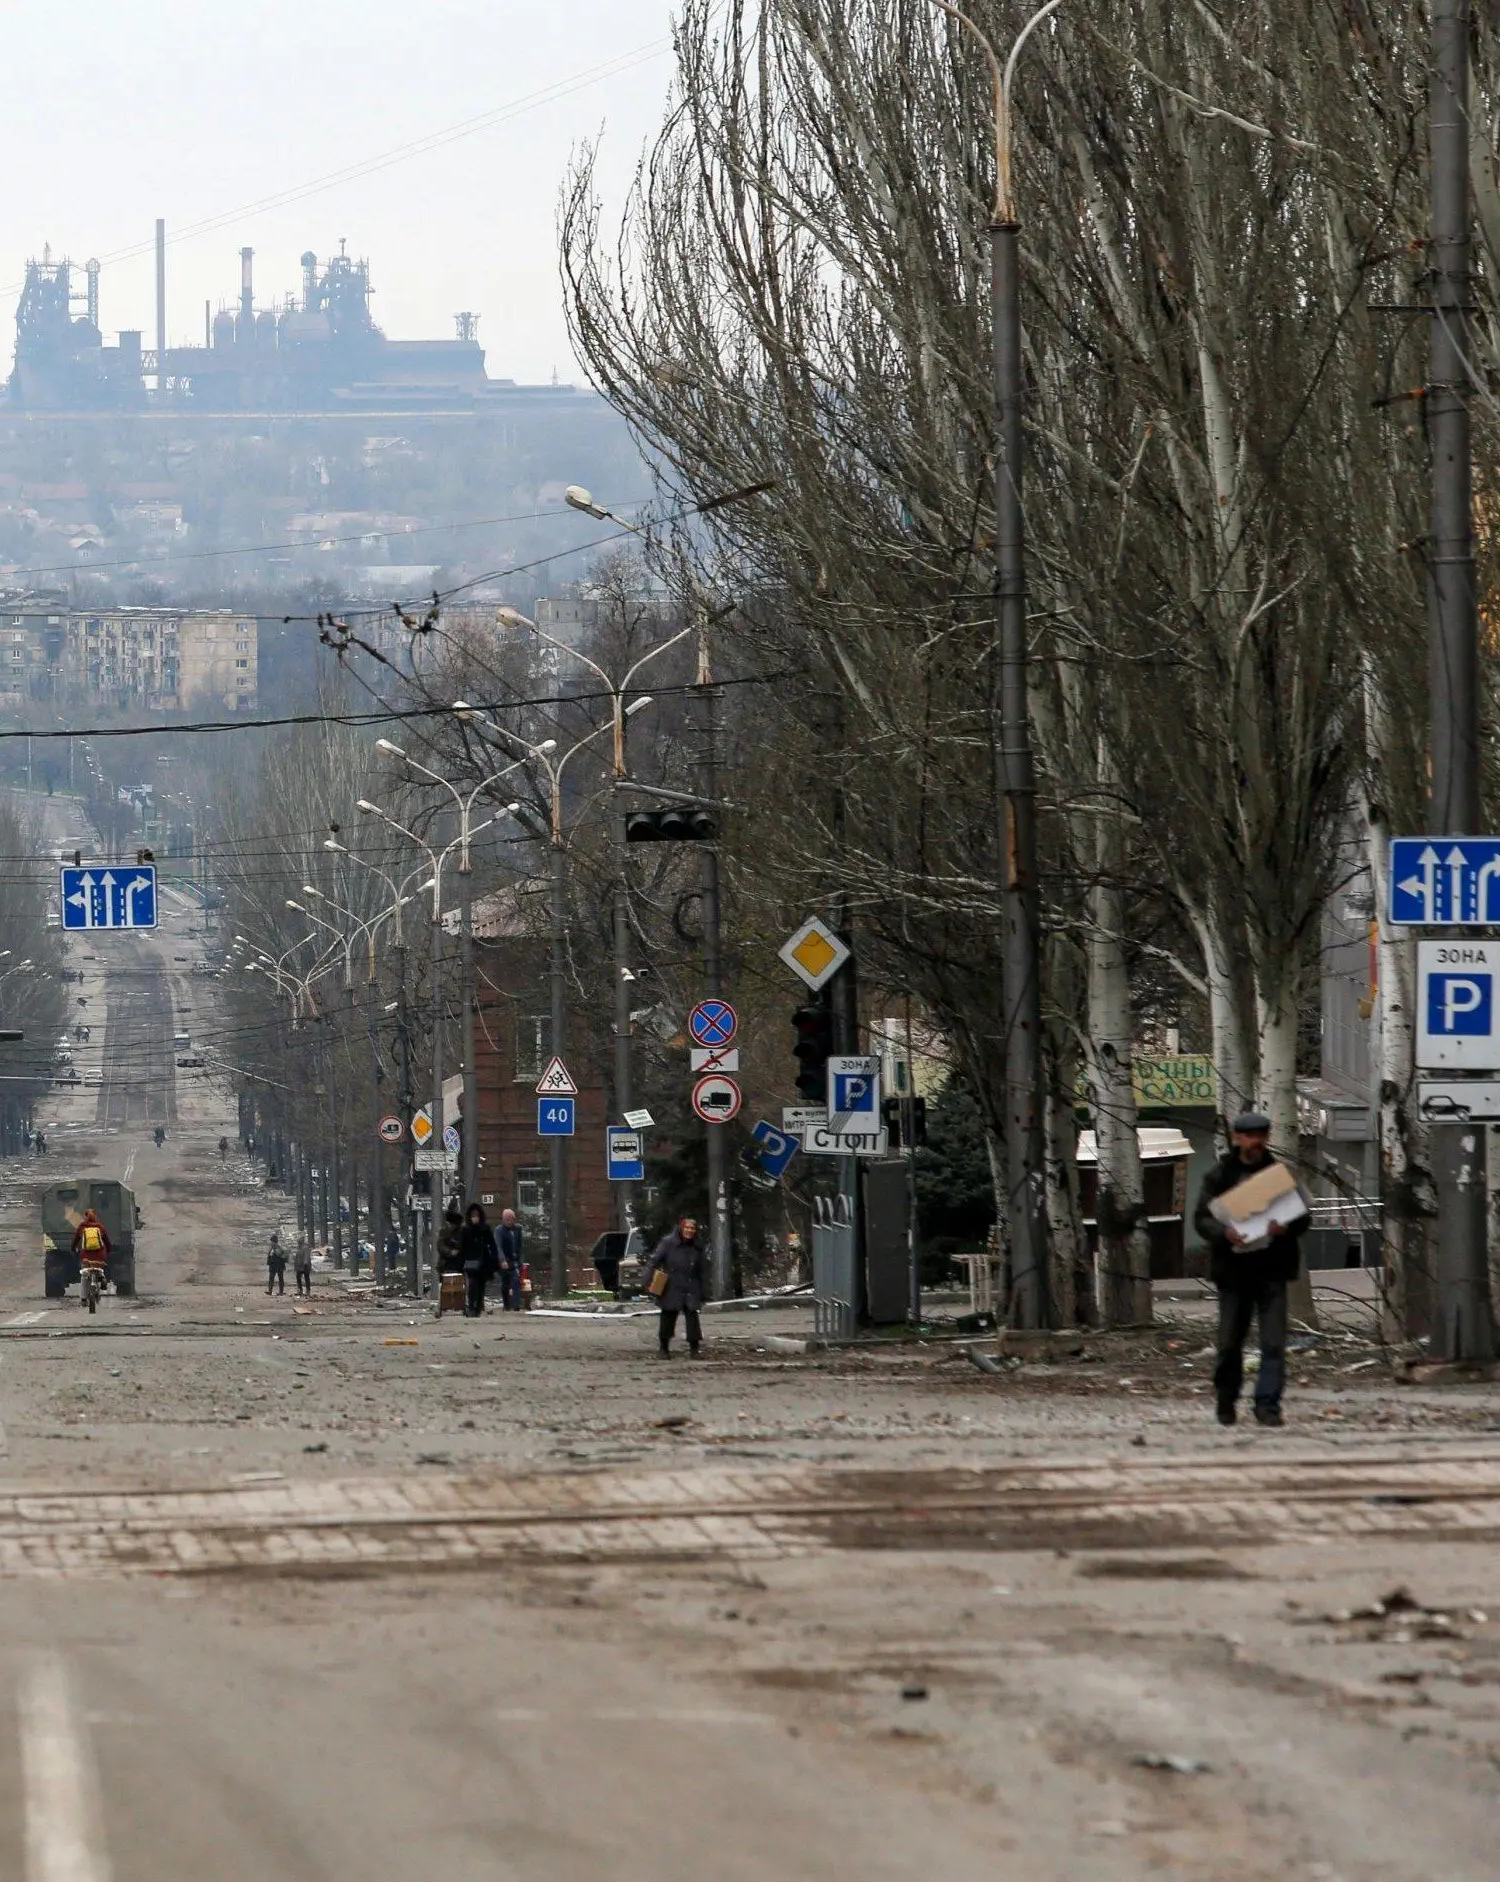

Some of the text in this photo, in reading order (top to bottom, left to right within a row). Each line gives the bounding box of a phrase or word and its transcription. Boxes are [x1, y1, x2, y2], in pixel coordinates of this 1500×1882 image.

[1437, 949, 1488, 964] ЗОНА
[1444, 979, 1482, 1030] P
[841, 1060, 871, 1070] ЗОНА
[546, 1108, 568, 1123] 40
